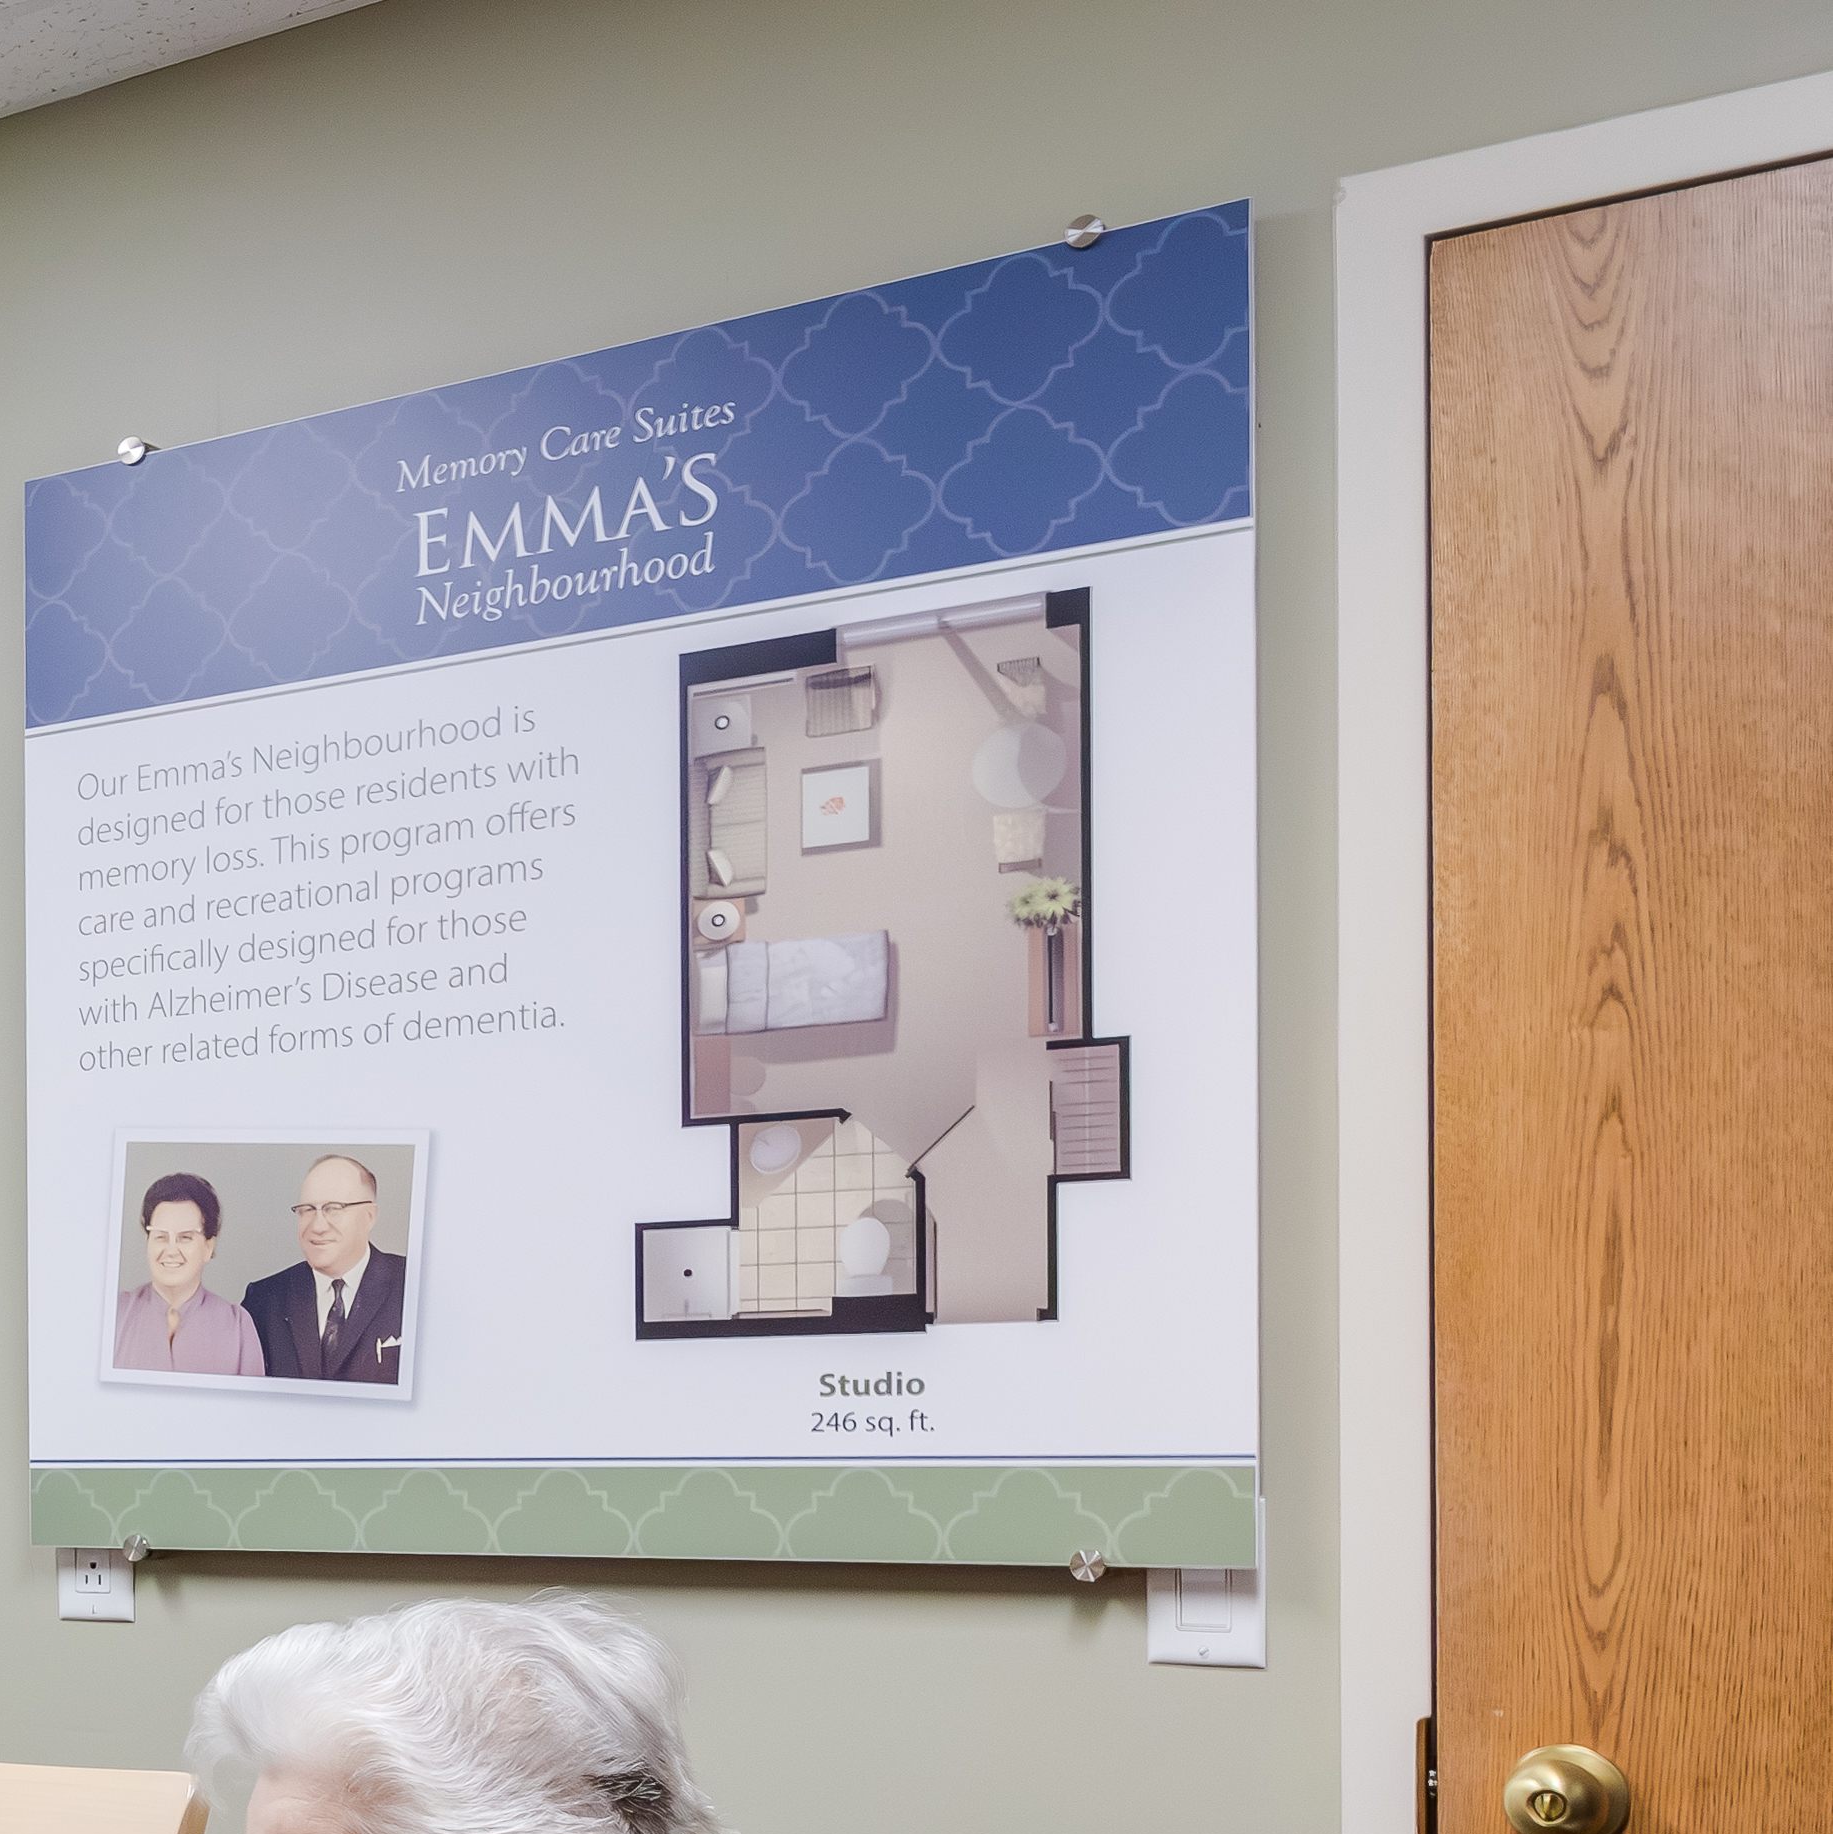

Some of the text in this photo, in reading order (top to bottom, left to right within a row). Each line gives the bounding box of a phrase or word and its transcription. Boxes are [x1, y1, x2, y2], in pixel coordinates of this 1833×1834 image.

[397, 402, 736, 492] Memory Care Suites
[415, 453, 719, 578] EMMA'S
[417, 531, 715, 625] Neighbourhood
[78, 706, 535, 800] Our Emma's Neighbourhood is
[78, 746, 578, 846] designed for those residents with
[79, 800, 575, 891] memory loss. This program offers
[79, 858, 543, 936] care and recreational programs
[79, 909, 527, 987] specifically designed for those
[79, 953, 507, 1026] with Alzheimer's Disease and
[80, 1001, 564, 1071] other related forms of dementia.
[811, 1409, 934, 1437] 246 sq. ft.
[820, 1371, 925, 1397] Studio
